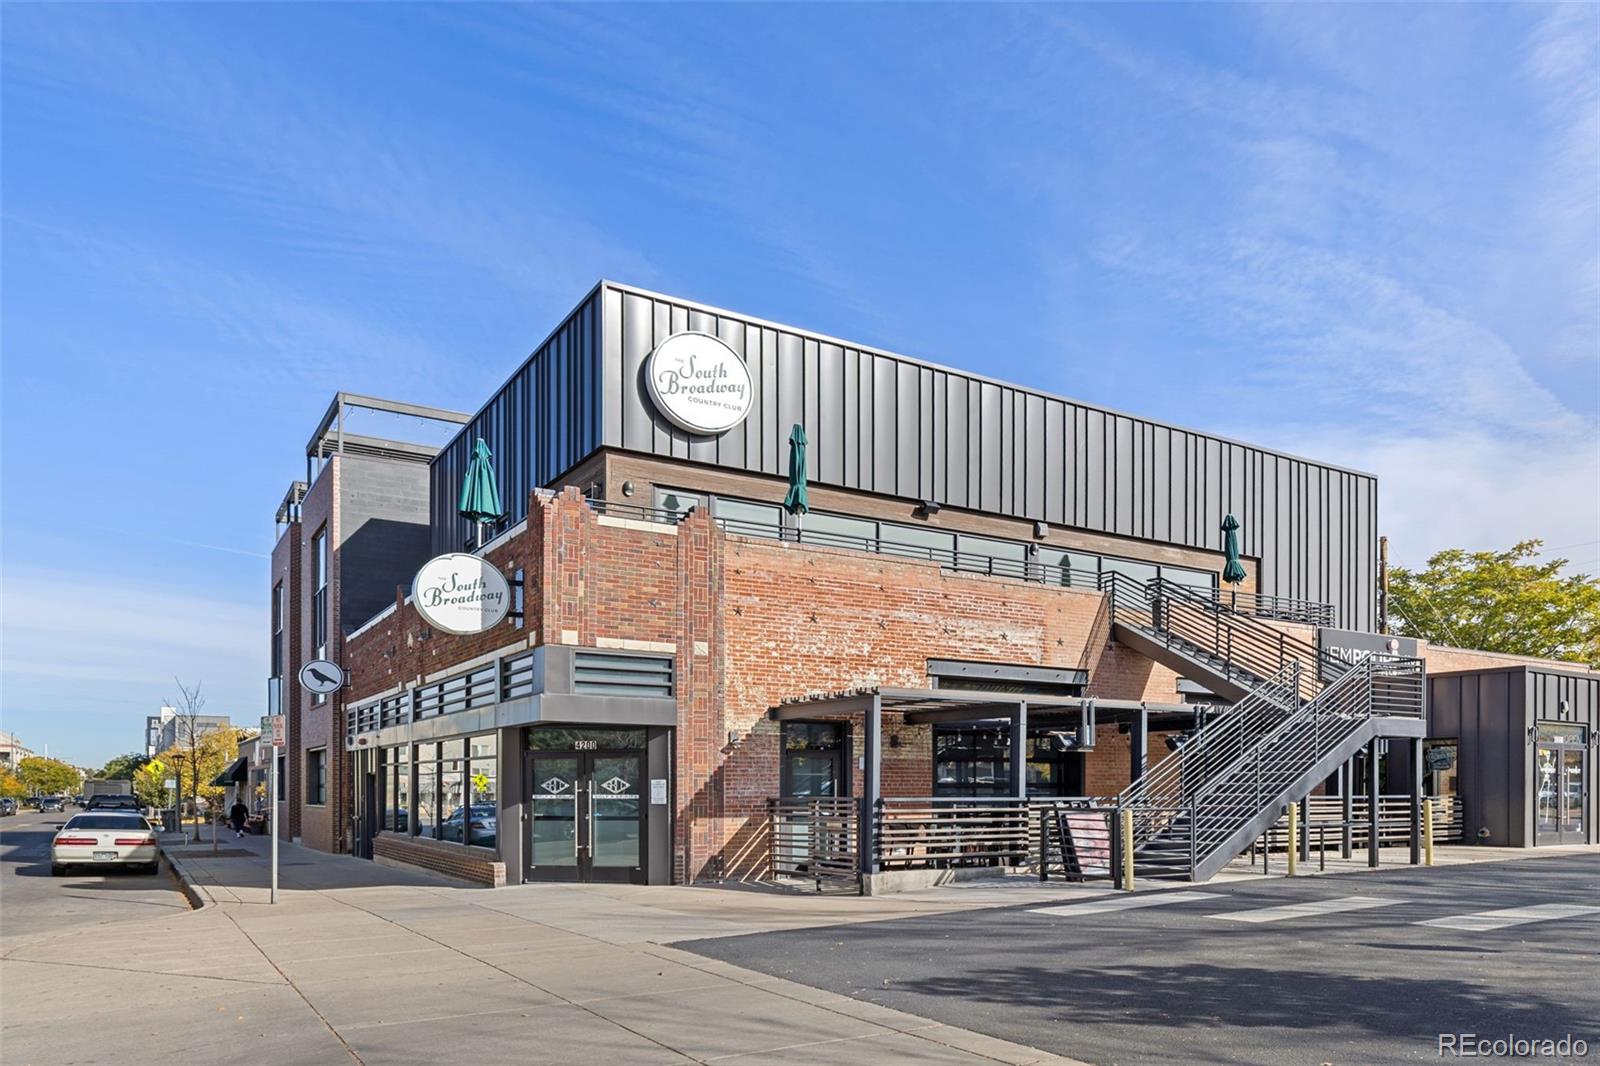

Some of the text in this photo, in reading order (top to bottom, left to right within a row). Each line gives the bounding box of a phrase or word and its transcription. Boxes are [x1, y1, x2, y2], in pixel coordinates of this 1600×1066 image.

[679, 354, 728, 379] South
[659, 370, 745, 400] Broadway
[687, 396, 742, 411] COUNTRY CLUB
[442, 572, 487, 593] South
[423, 587, 503, 608] Broadway
[574, 740, 597, 750] 4200
